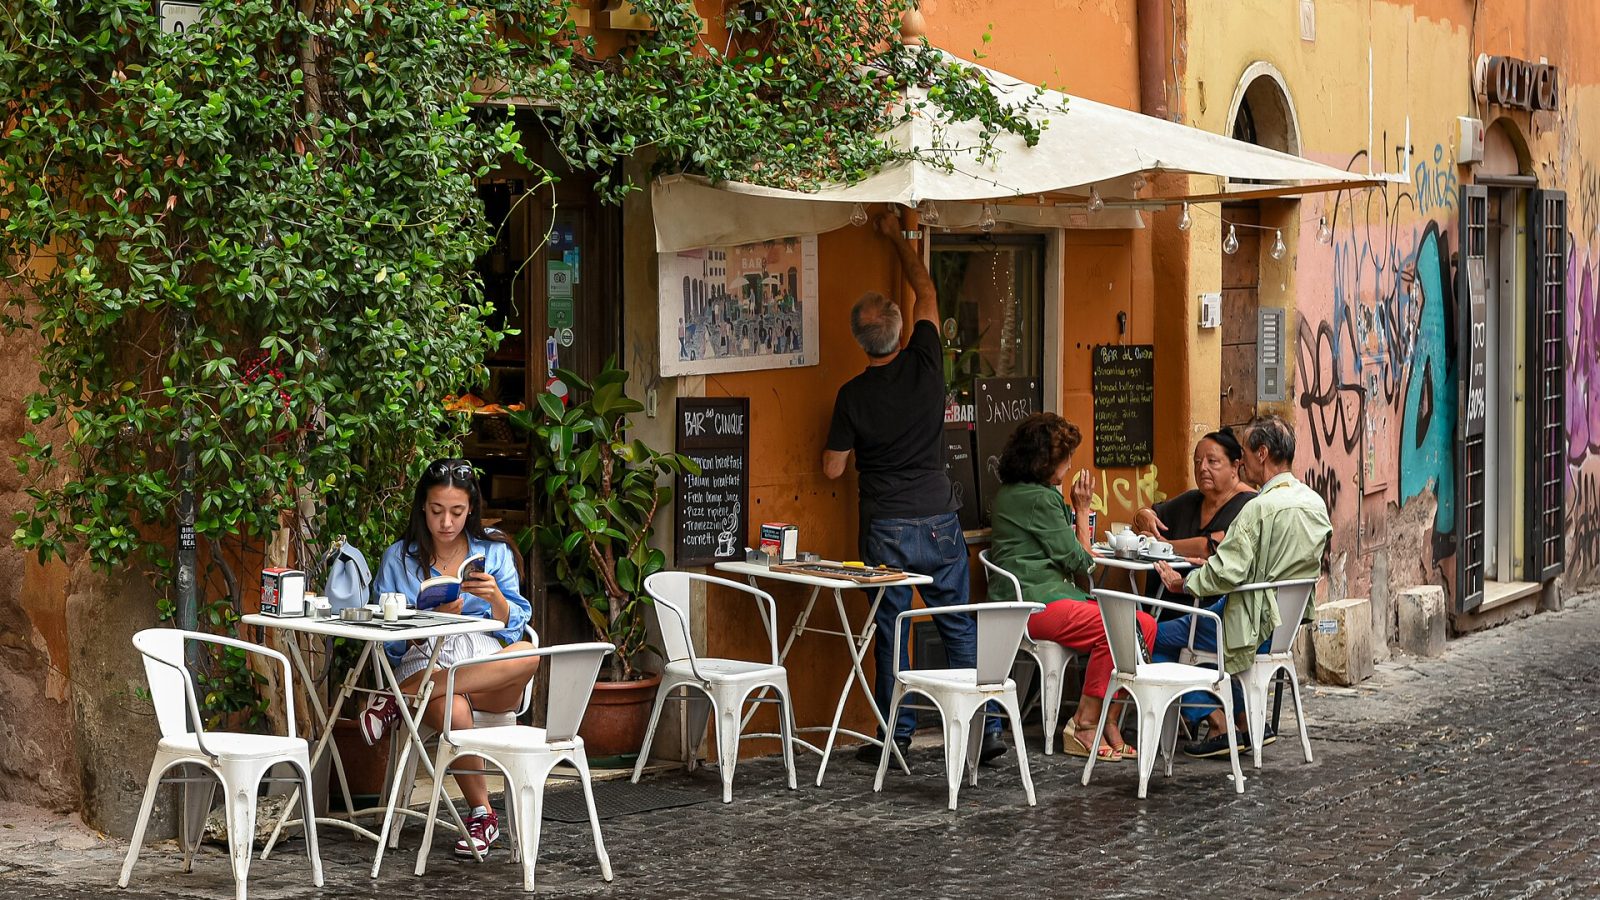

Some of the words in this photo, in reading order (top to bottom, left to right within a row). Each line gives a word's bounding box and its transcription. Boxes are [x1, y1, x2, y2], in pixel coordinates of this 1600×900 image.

[741, 257, 763, 269] BAR
[1100, 347, 1118, 364] BAR
[1470, 388, 1485, 421] 30%
[954, 404, 974, 422] BAR
[684, 411, 706, 437] BAR
[714, 413, 744, 436] CINQUE
[715, 455, 743, 471] breakfast
[687, 474, 710, 489] Italian
[713, 474, 740, 489] breakfast
[687, 491, 704, 503] Fresh
[686, 505, 705, 518] Pizze
[706, 506, 730, 521] ripiene
